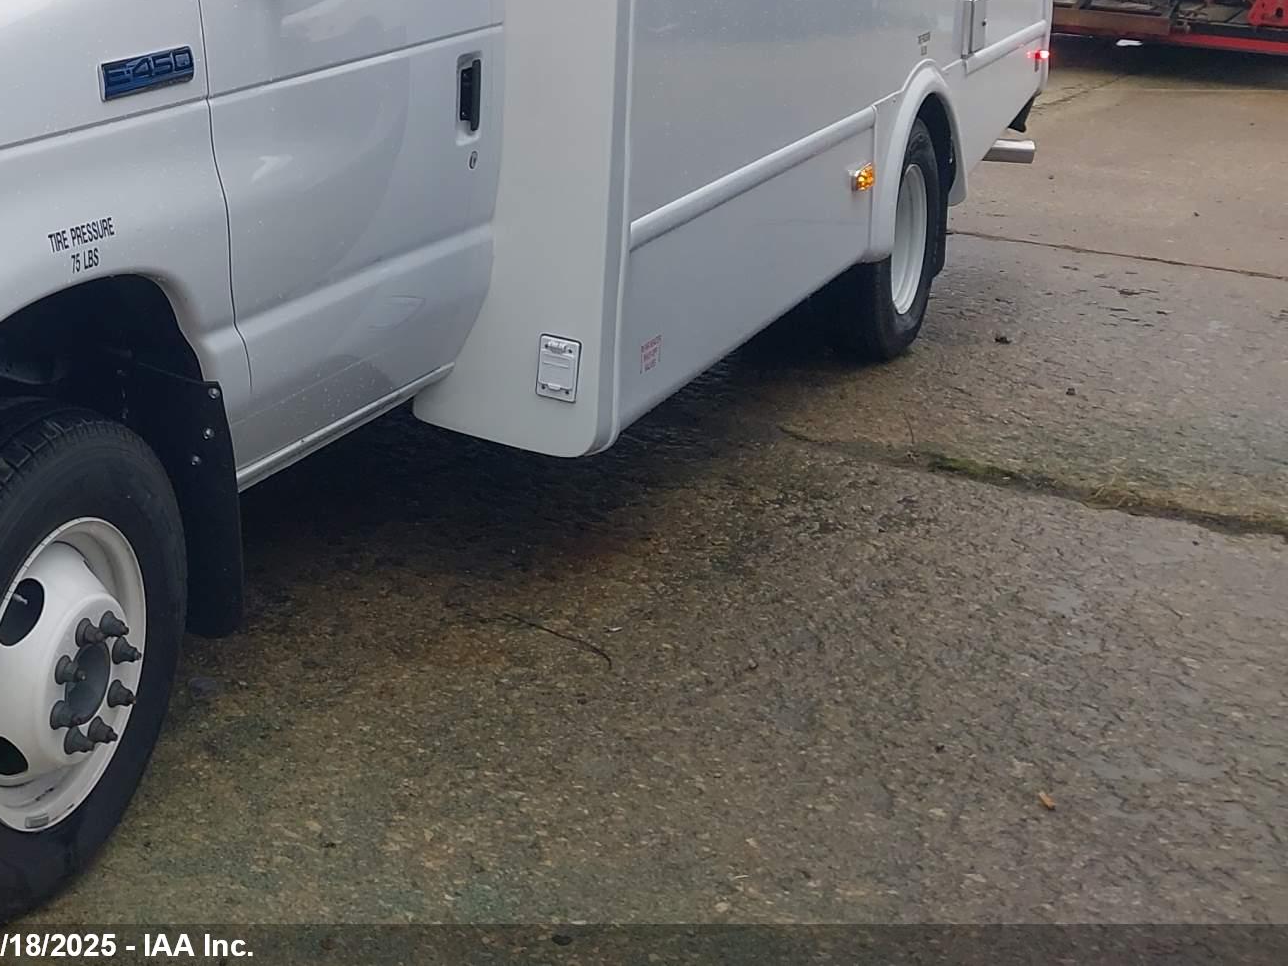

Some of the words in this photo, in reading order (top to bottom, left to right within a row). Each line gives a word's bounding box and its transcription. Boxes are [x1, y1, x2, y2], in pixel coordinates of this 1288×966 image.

[107, 52, 194, 81] E-450
[48, 229, 70, 253] TIRE
[70, 217, 115, 247] PRESSURE
[71, 253, 81, 274] 75
[83, 247, 100, 270] LBS
